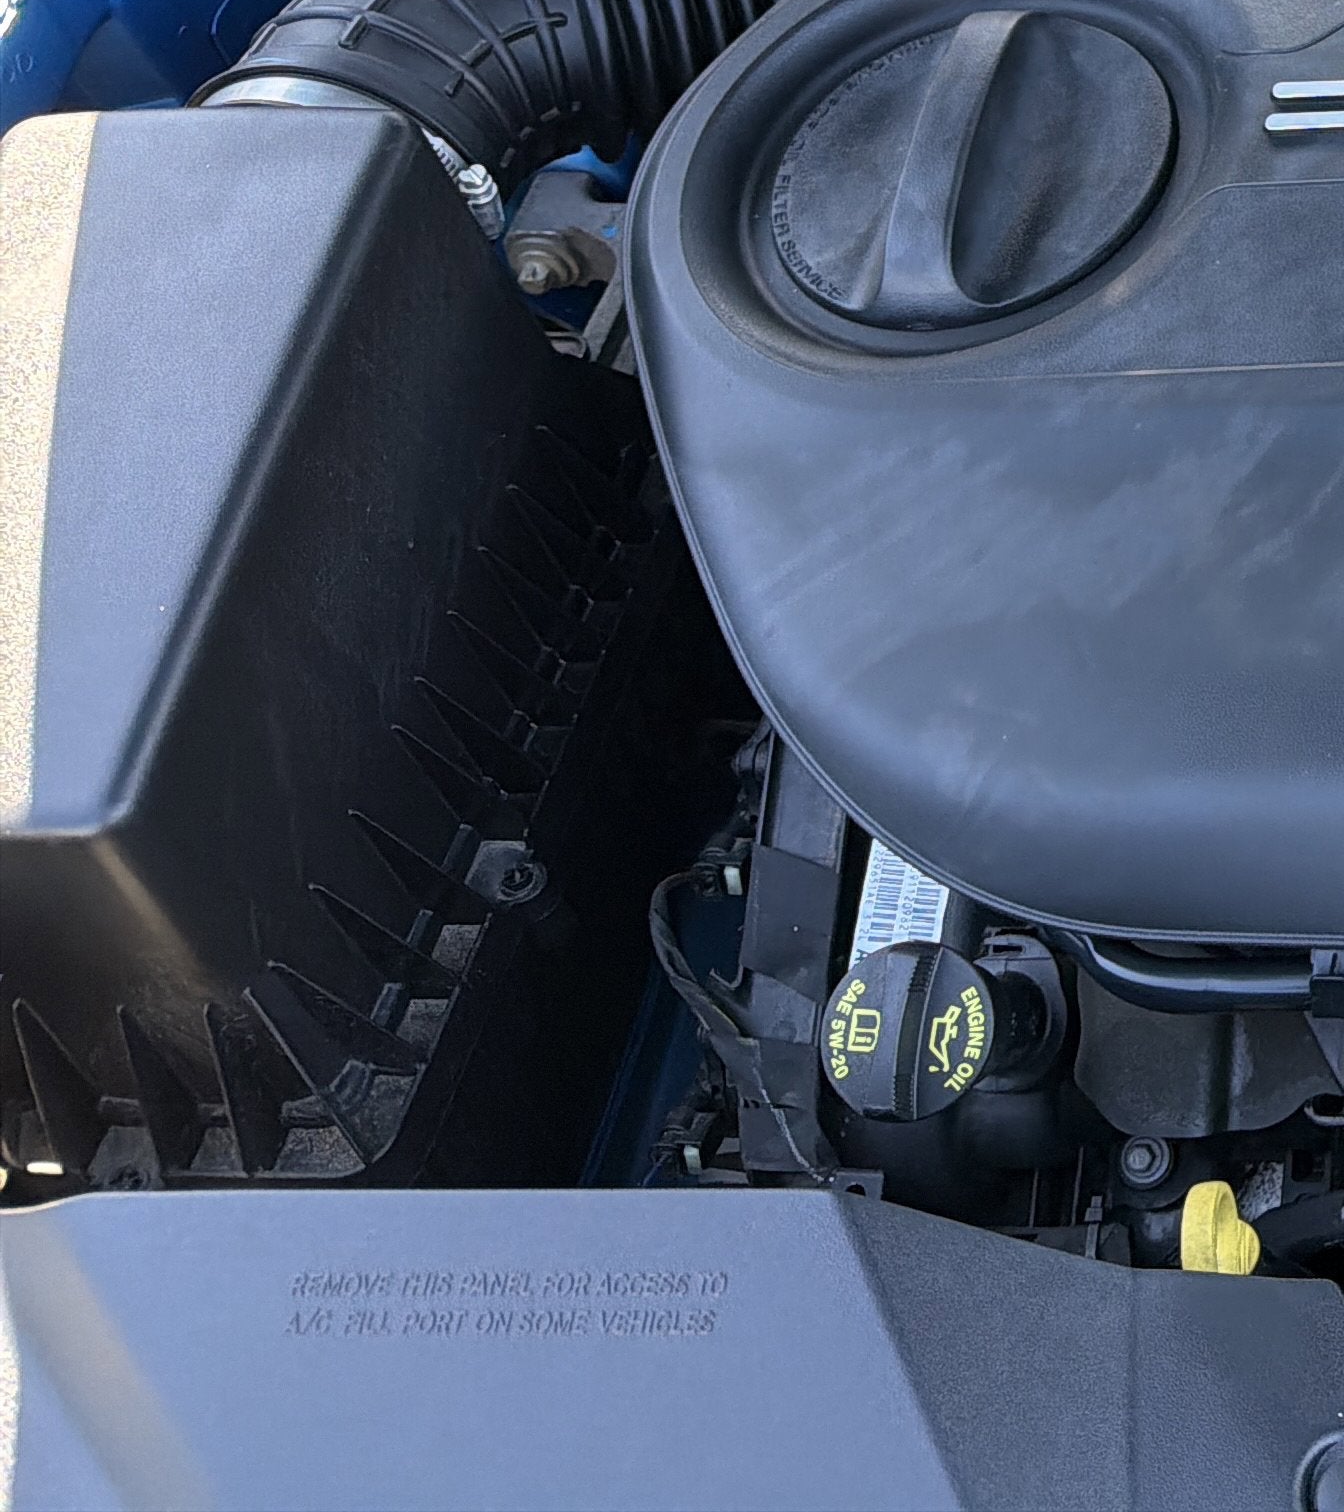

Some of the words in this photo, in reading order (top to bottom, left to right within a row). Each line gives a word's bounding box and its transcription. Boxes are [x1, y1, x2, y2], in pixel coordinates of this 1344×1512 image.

[773, 174, 791, 237] FILTER
[781, 239, 848, 302] SERVICE
[835, 977, 866, 1017] SAE
[960, 985, 986, 1061] ENGINE
[828, 1018, 850, 1081] 5W-20
[943, 1062, 975, 1092] OIL
[291, 1271, 391, 1298] REMOVE
[401, 1271, 455, 1298] THIS
[460, 1271, 535, 1298] PANEL
[542, 1271, 593, 1298] FOR
[597, 1271, 692, 1298] ACCESS
[697, 1271, 729, 1297] TO
[285, 1308, 332, 1337] A/C
[344, 1309, 391, 1336] FILL
[403, 1309, 467, 1336] PORT
[475, 1309, 517, 1336] ON
[519, 1309, 592, 1336] SOME
[601, 1308, 717, 1336] VEHICLES
